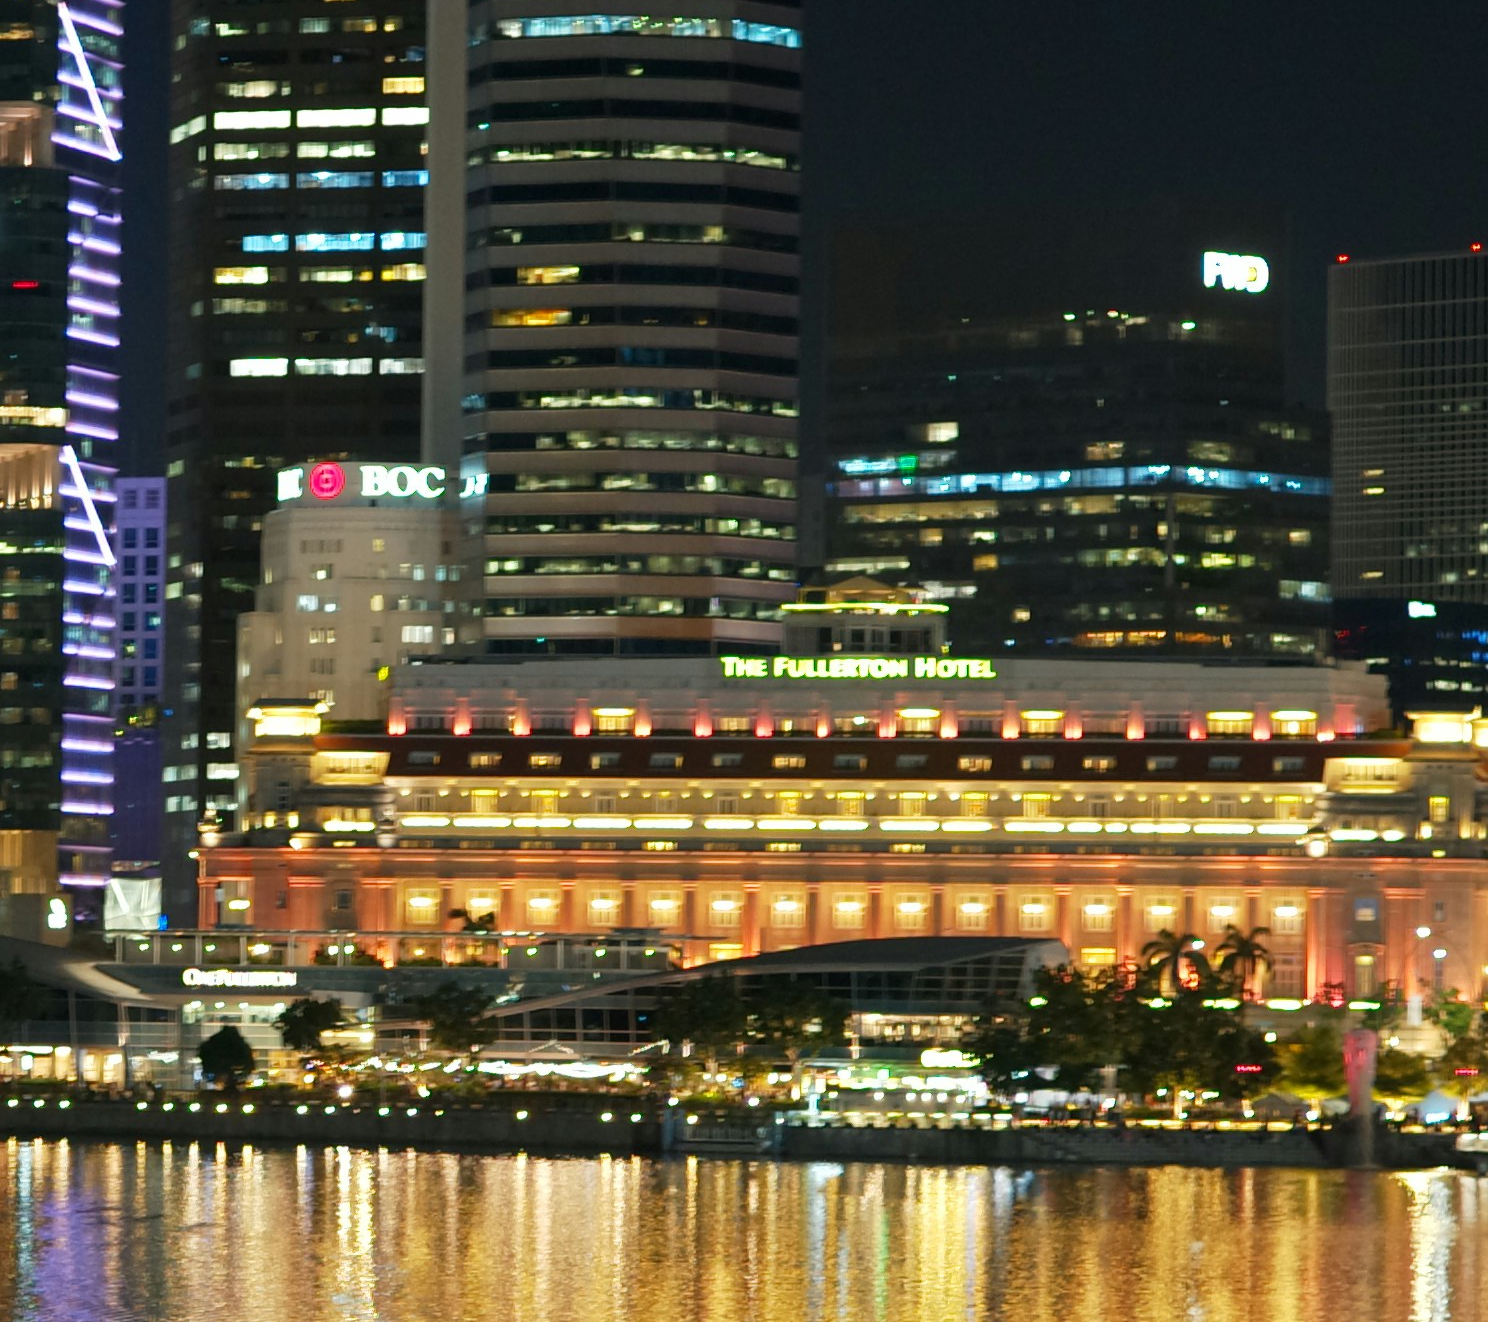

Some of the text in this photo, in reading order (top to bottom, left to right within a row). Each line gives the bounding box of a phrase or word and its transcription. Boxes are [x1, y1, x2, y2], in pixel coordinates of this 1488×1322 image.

[360, 465, 446, 498] BOC
[721, 656, 997, 678] THE FULLERTON HOTEL
